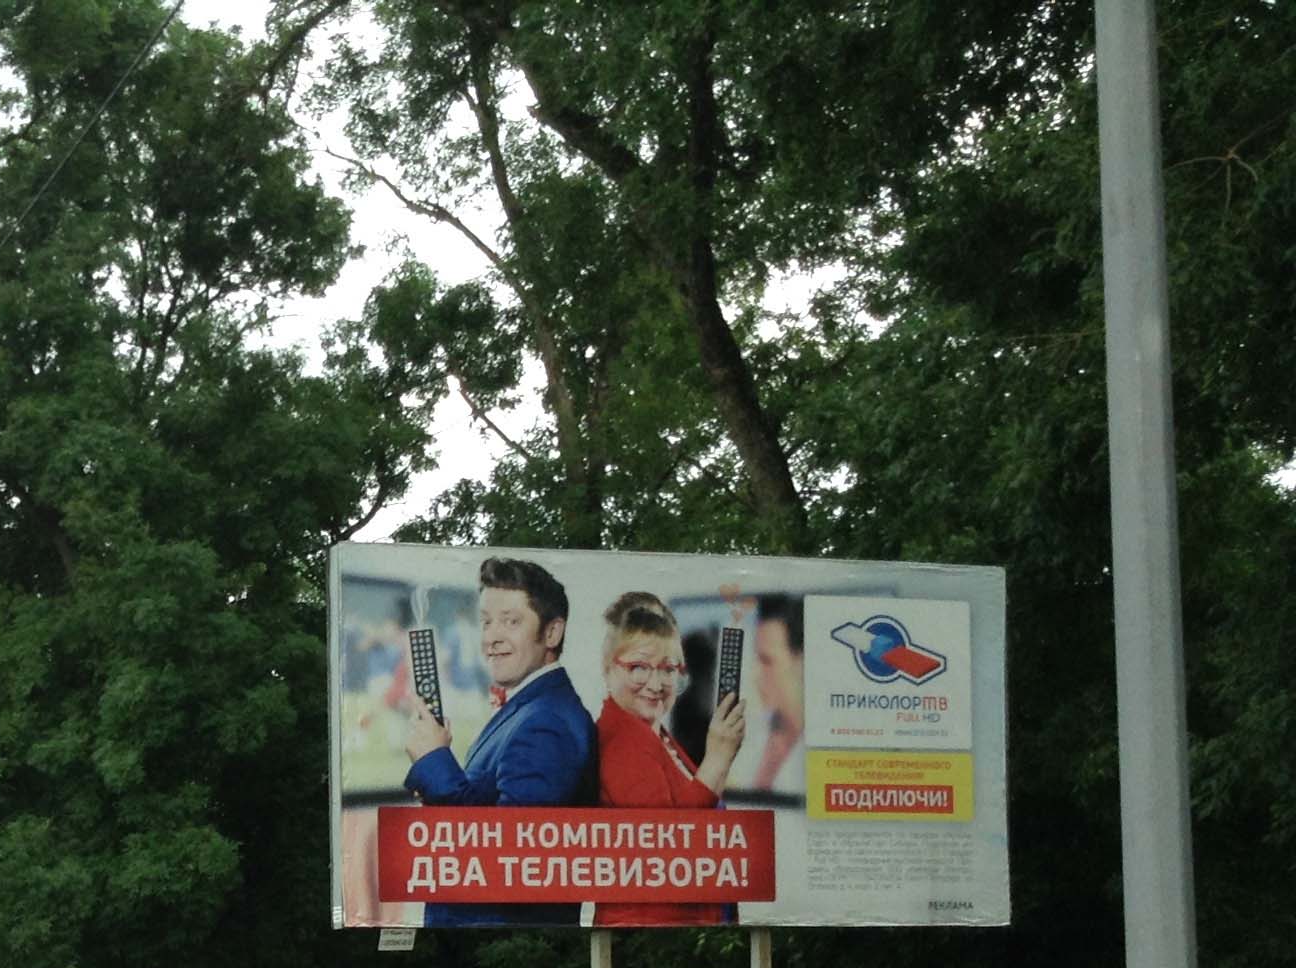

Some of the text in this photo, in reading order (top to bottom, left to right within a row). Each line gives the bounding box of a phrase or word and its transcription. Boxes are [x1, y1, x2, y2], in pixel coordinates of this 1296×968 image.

[830, 788, 948, 810] ПОДКЛЮЧИ!
[407, 821, 749, 853] ОДИН КОМПЛЕКТ НА
[406, 855, 749, 894] ДВА ТЕЛЕВИЗОРА!
